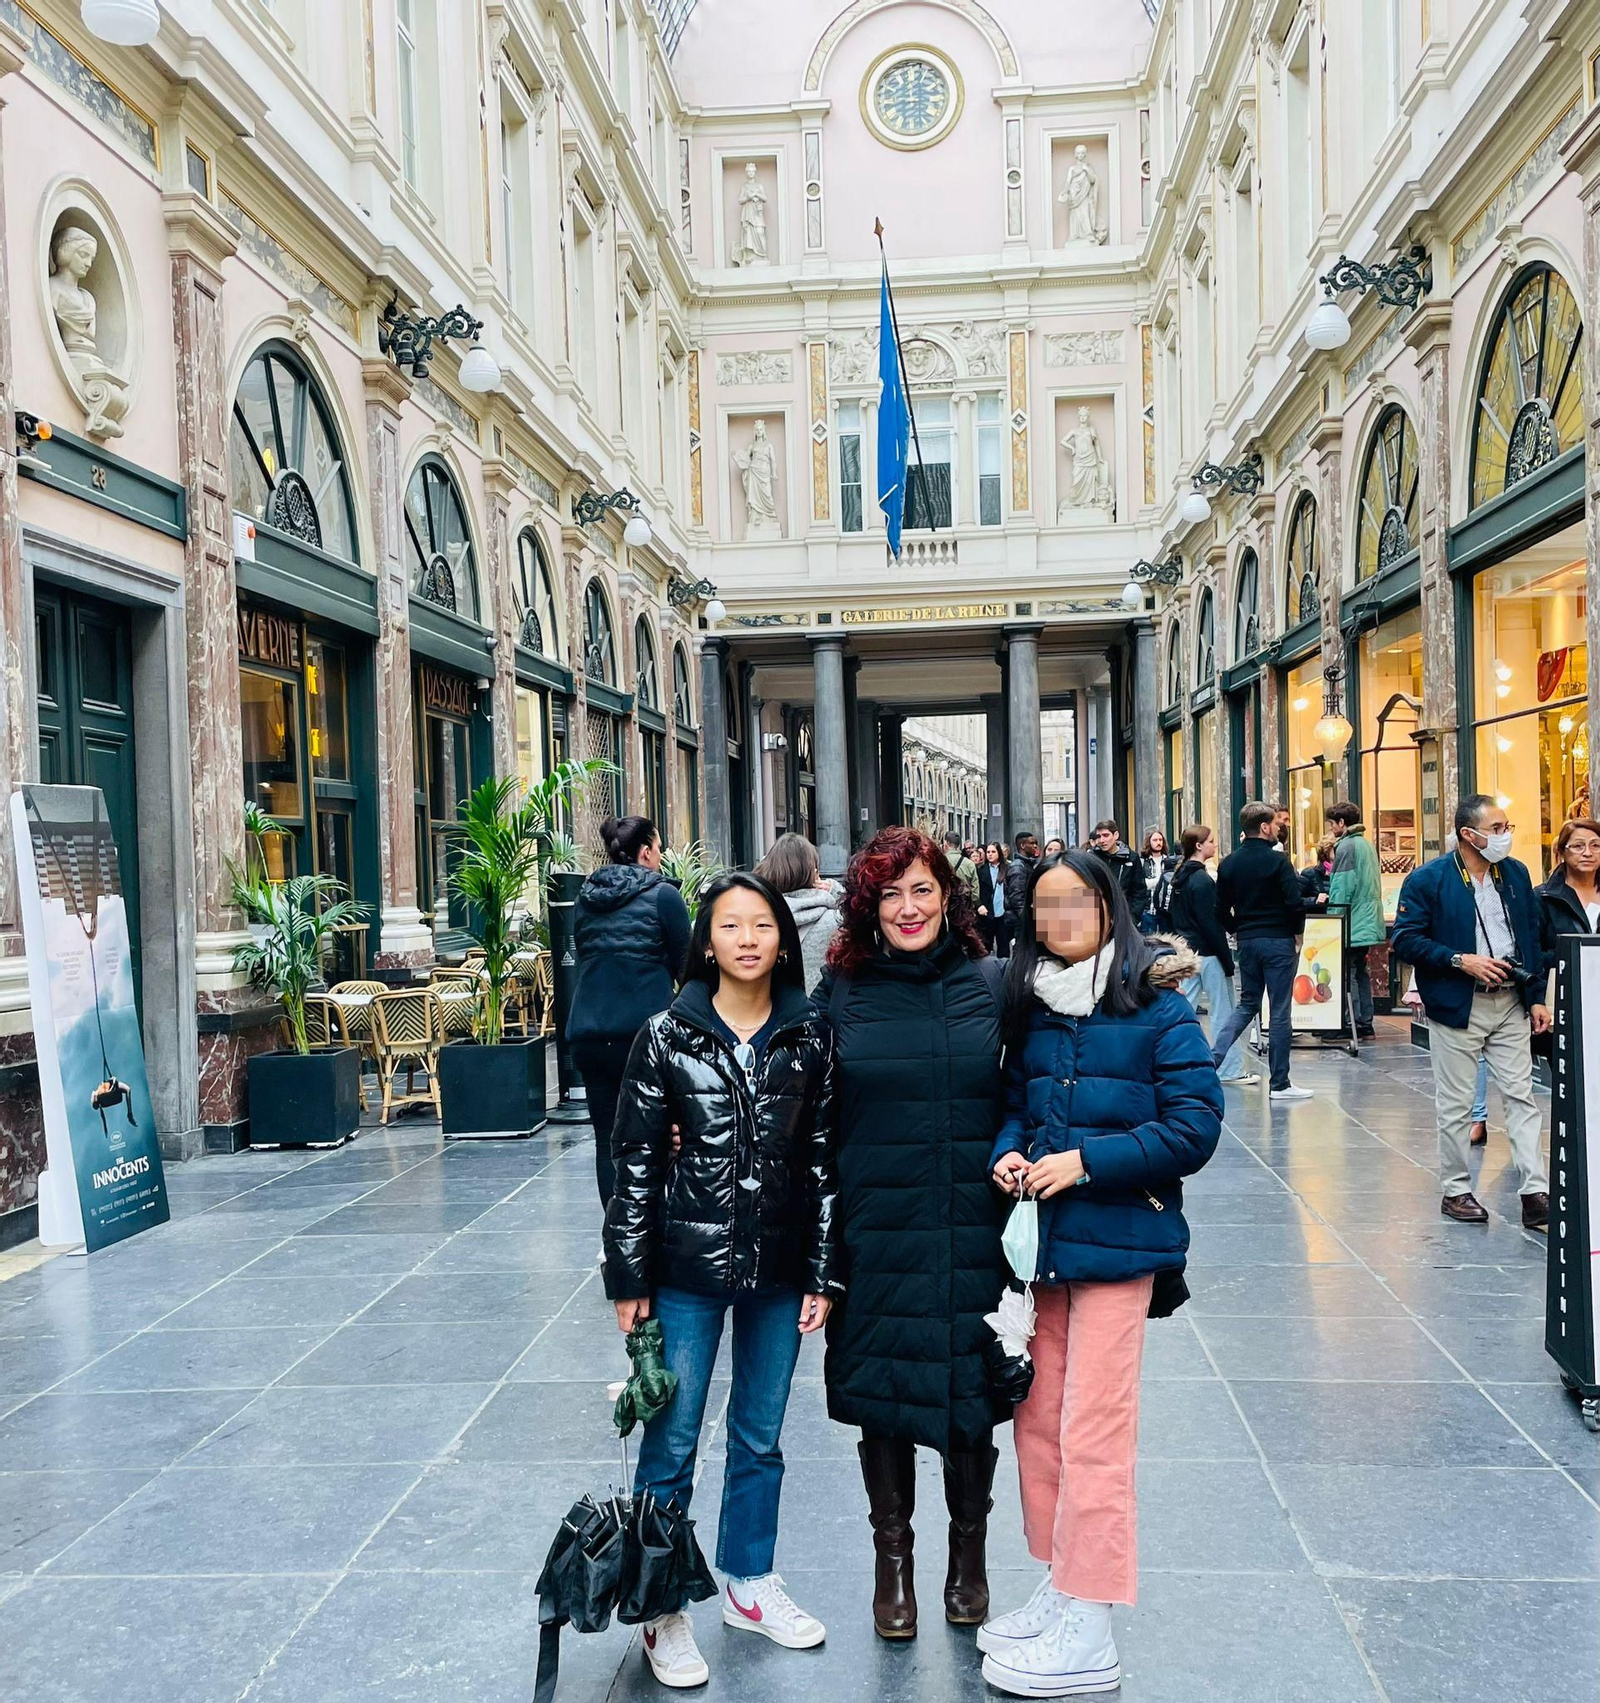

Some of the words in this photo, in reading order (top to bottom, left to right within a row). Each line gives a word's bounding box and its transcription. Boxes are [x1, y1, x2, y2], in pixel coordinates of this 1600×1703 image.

[91, 464, 107, 490] 28
[843, 609, 908, 623] GALERIE
[911, 607, 931, 620] DE
[935, 606, 954, 620] LA
[957, 604, 1006, 619] REINE
[426, 668, 471, 715] PASSAGE
[1558, 959, 1566, 1099] PIERRE
[92, 1155, 150, 1190] INNOCENTS
[1558, 1121, 1567, 1338] MARCOLINI
